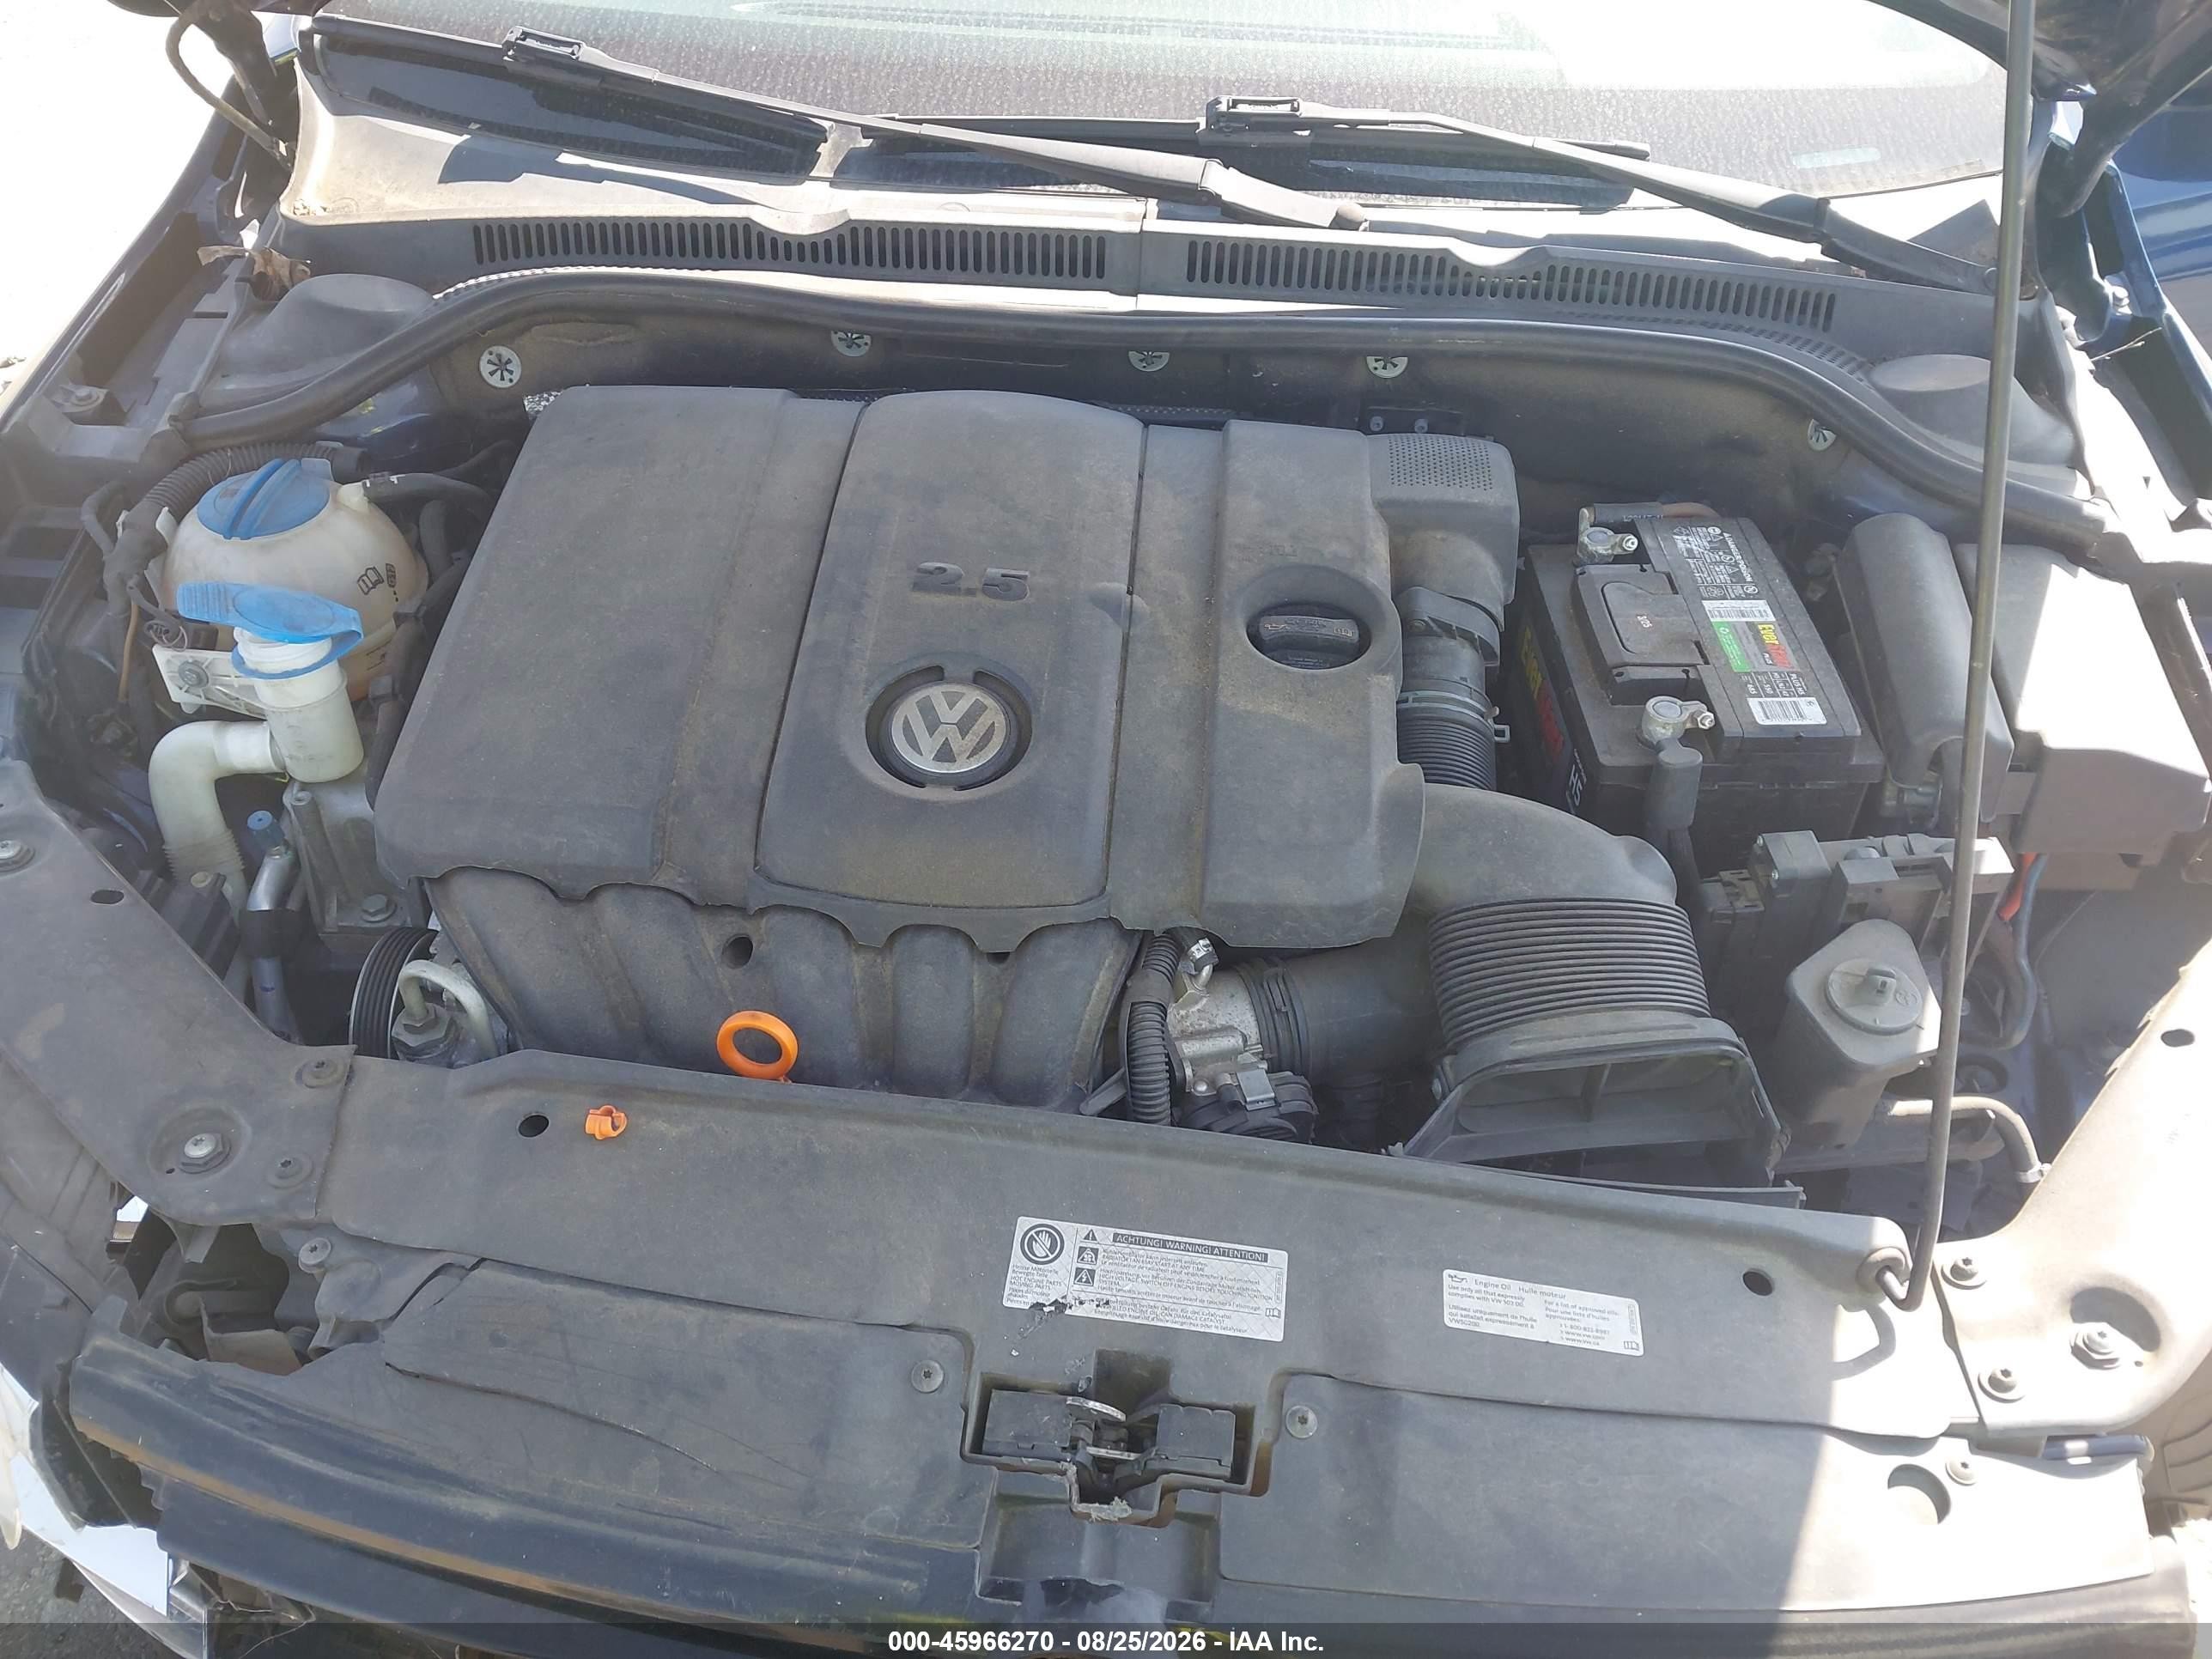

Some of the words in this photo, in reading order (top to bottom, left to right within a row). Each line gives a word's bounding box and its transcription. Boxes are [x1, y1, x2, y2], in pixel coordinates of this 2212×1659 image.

[912, 562, 1031, 602] 2.5
[1116, 1233, 1163, 1248] ACHTUNG!
[1164, 1240, 1212, 1255] WARNING!
[1212, 1247, 1265, 1261] ATTENTION!
[1474, 1279, 1498, 1290] Engine
[1483, 1289, 1496, 1297] that
[1518, 1285, 1537, 1294] Huile
[1539, 1289, 1565, 1299] moteur
